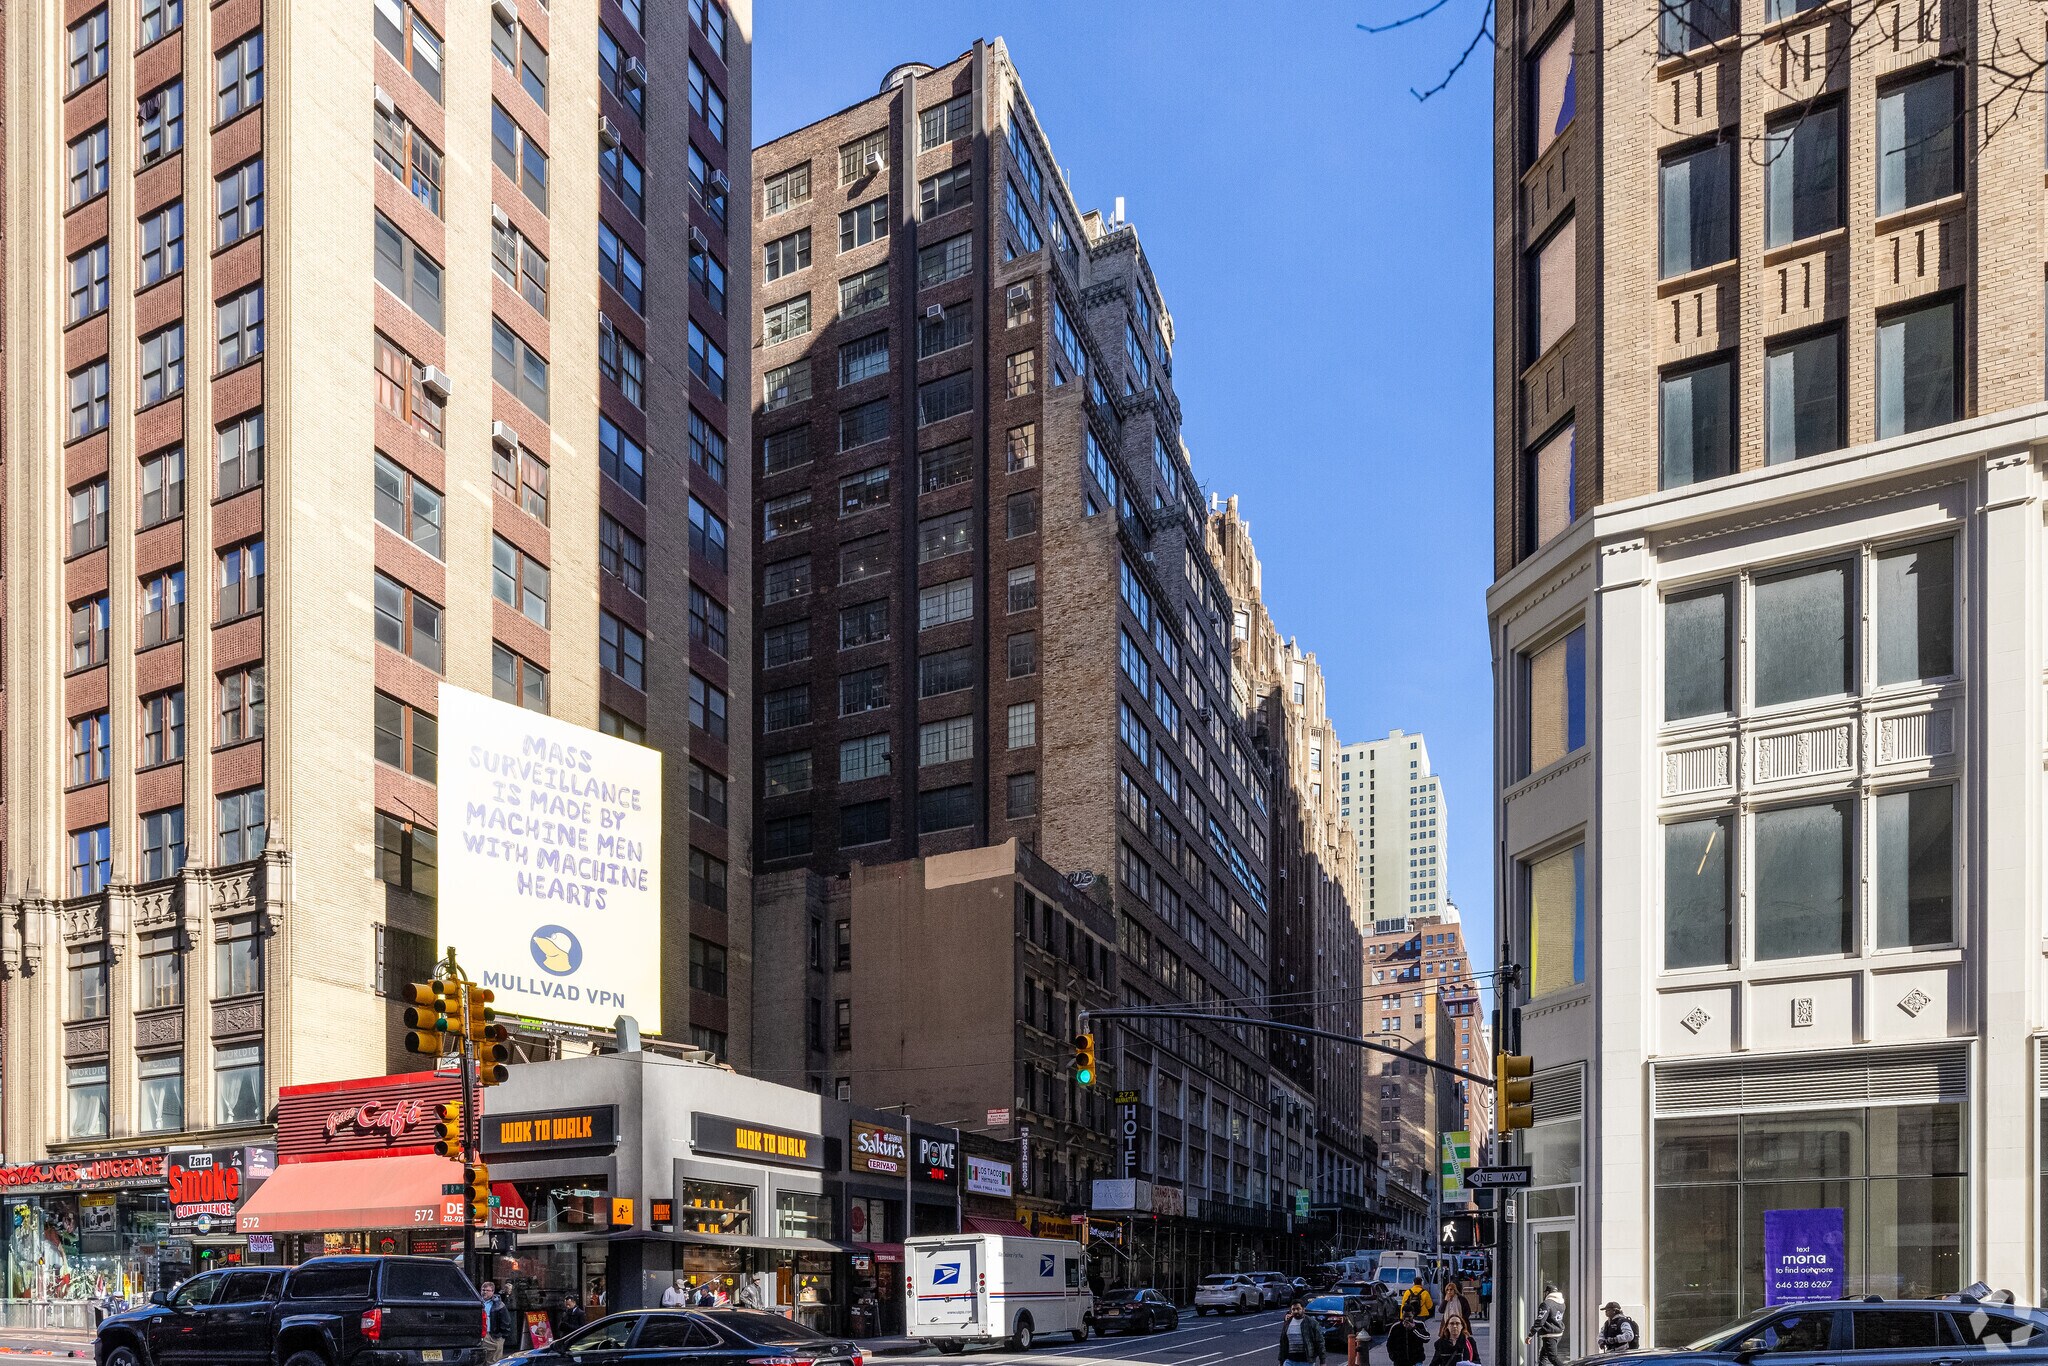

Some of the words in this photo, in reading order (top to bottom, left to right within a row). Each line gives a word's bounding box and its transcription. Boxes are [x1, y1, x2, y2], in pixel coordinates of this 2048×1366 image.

[522, 734, 592, 773] MASS
[468, 746, 641, 811] SURVEILLANCE
[492, 780, 522, 806] IS
[529, 790, 592, 824] MADE
[600, 808, 626, 831] BY
[466, 801, 589, 852] MACHINE
[597, 835, 643, 862] MEN
[462, 831, 529, 866] WITH
[536, 849, 648, 892] MACHINE
[517, 870, 608, 910] HEARTS
[483, 970, 580, 1001] MULLVAD
[586, 988, 625, 1009] VPN
[357, 1100, 424, 1137] Café
[501, 1121, 532, 1144] WOK
[534, 1119, 550, 1141] TO
[553, 1116, 592, 1140] WALK
[736, 1128, 762, 1151] WOK
[763, 1133, 776, 1154] TO
[777, 1135, 807, 1158] WALK
[857, 1132, 905, 1159] Sakura
[919, 1138, 955, 1169] POKE
[91, 1156, 163, 1180] LUGGAGE
[190, 1155, 212, 1167] Zara
[869, 1160, 897, 1171] TERIYAKI
[987, 1168, 1002, 1178] TACOS
[169, 1162, 239, 1204] Smoke
[1473, 1173, 1492, 1182] ONE
[1501, 1172, 1522, 1181] WAY
[176, 1203, 231, 1218] CONVENIENCE
[414, 1209, 434, 1222] 572
[653, 1204, 670, 1215] WOK
[242, 1217, 260, 1228] 572
[249, 1235, 273, 1244] SMOKE
[252, 1244, 273, 1252] SHOP
[1782, 1255, 1826, 1265] mona
[1784, 1266, 1799, 1274] find
[1775, 1281, 1792, 1289] 646
[1811, 1280, 1832, 1288] 6267
